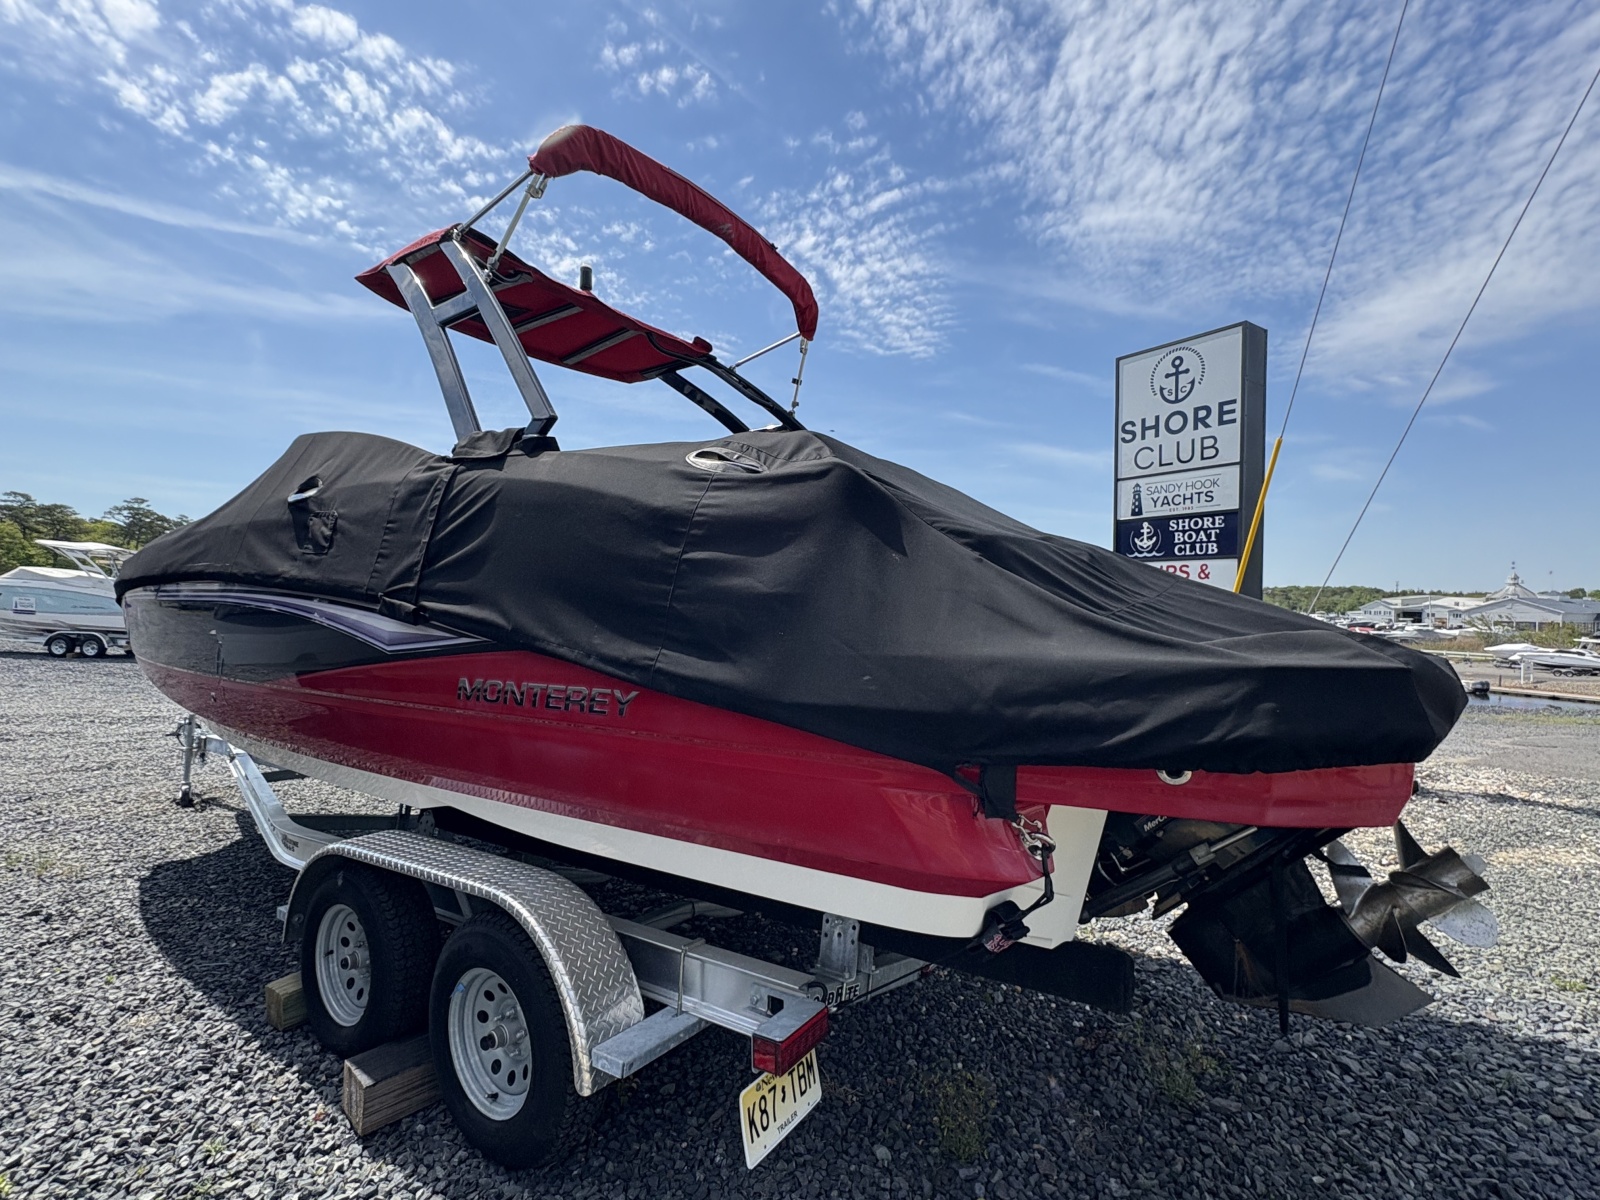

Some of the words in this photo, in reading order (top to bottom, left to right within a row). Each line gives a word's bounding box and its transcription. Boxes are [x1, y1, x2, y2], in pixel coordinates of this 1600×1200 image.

[1167, 389, 1174, 397] S
[1180, 385, 1188, 394] C
[1120, 398, 1238, 444] SHORE
[1133, 435, 1220, 470] CLUB
[1146, 482, 1183, 496] SANDY
[1185, 478, 1220, 491] HOOK
[1150, 490, 1215, 508] YACHTS
[1168, 515, 1225, 531] SHORE
[1173, 529, 1220, 543] BOAT
[1173, 542, 1219, 556] CLUB
[1197, 563, 1211, 580] &
[457, 677, 640, 717] MONTEREY
[776, 1110, 798, 1135] TRAILER
